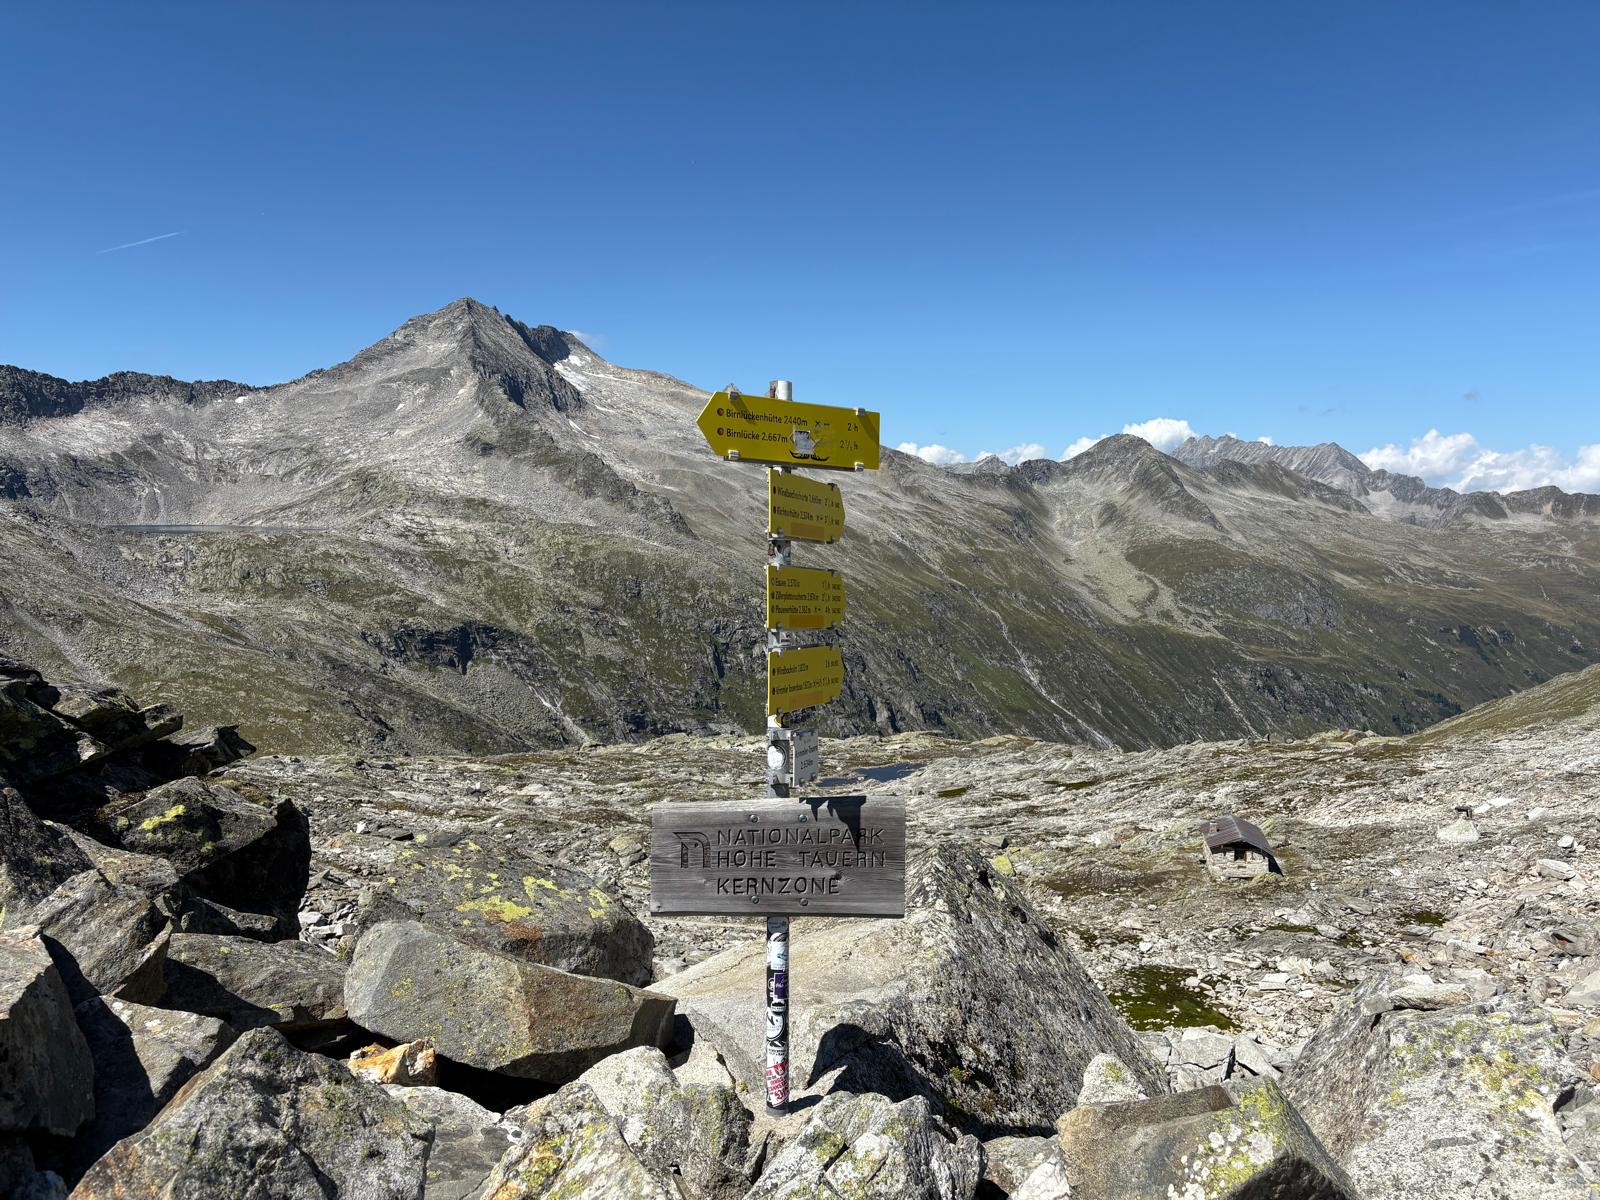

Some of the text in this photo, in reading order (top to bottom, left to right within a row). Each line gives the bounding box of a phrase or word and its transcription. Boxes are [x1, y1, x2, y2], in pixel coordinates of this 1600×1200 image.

[726, 409, 782, 424] Birnlückenhütte
[726, 428, 788, 444] Birnlücke 2.667m
[716, 828, 885, 846] NATIONALPARK
[716, 850, 886, 868] HOHE TAUERN
[716, 876, 840, 895] KERNZONE
